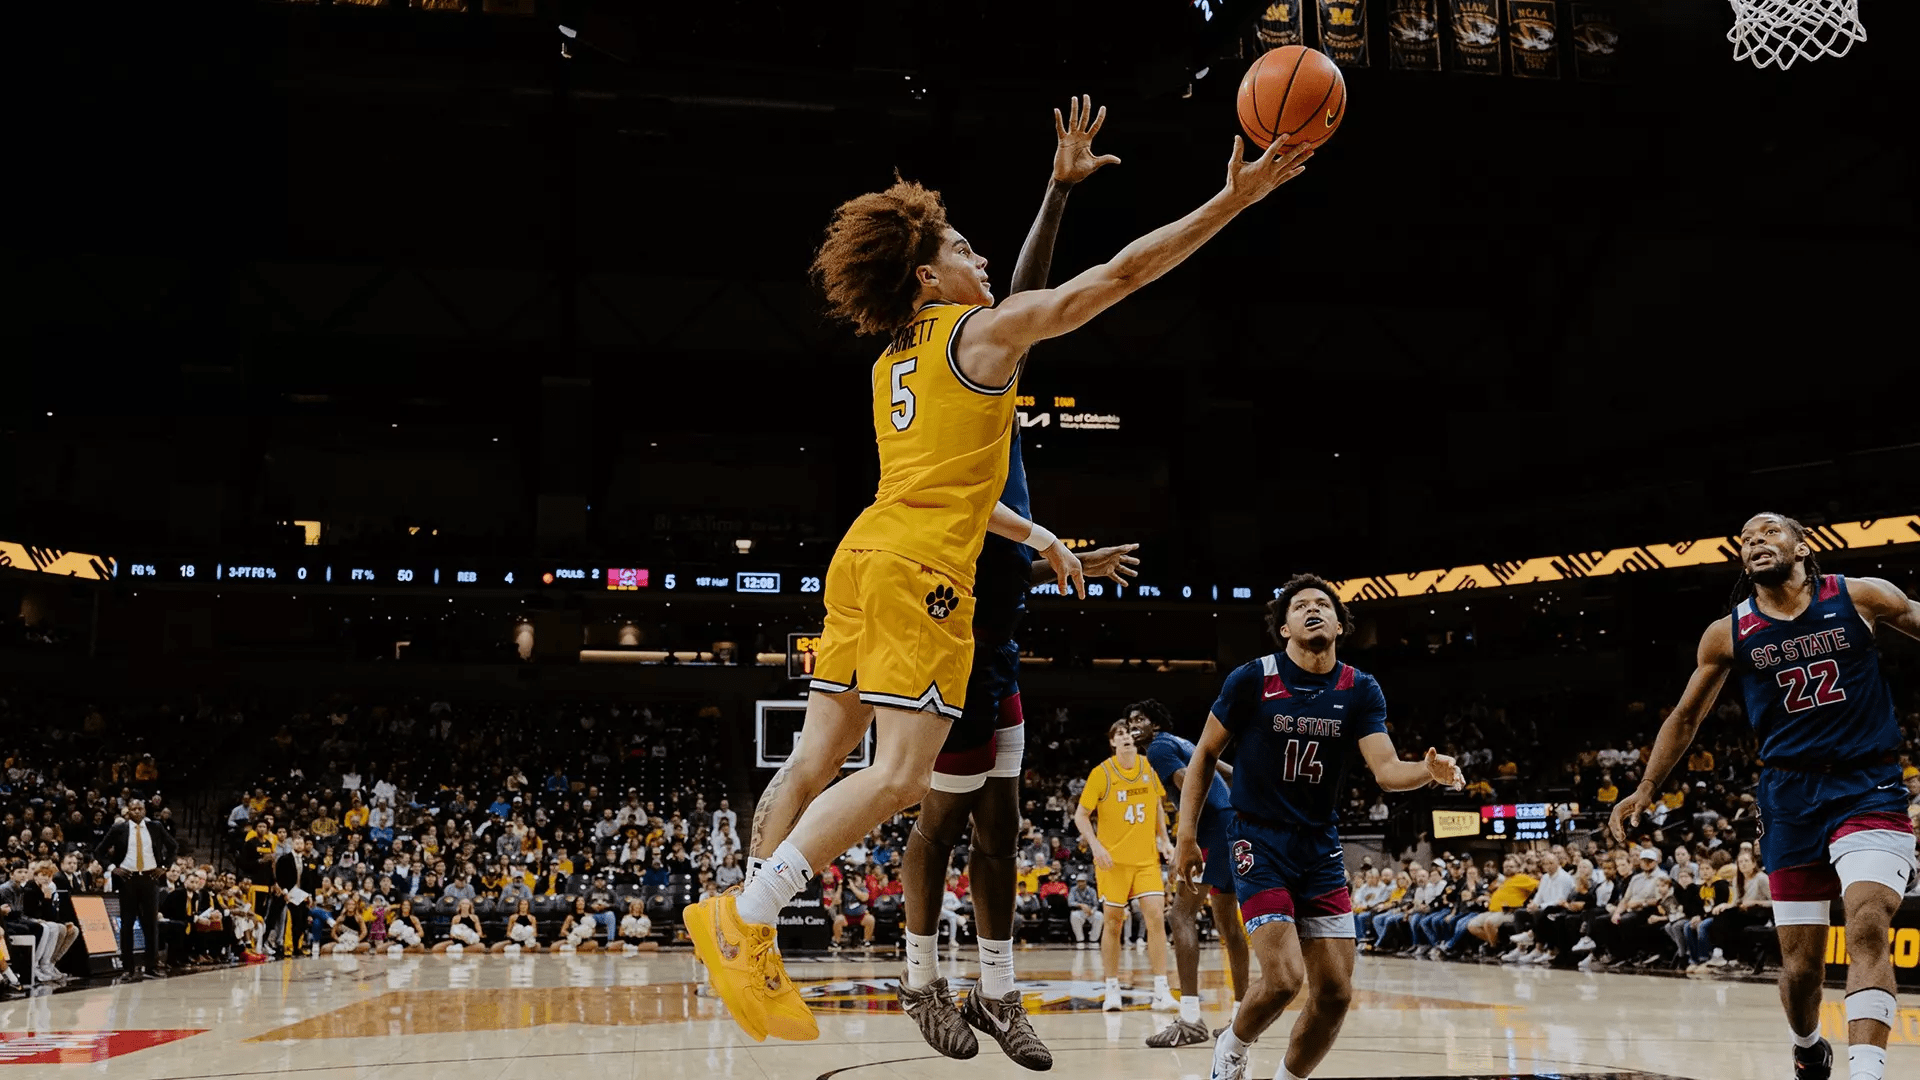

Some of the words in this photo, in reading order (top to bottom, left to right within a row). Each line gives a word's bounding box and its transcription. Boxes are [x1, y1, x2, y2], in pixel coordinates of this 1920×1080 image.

[1516, 7, 1548, 20] NCAA
[890, 356, 918, 432] 5
[1074, 413, 1084, 422] of
[131, 565, 145, 576] FG
[179, 565, 195, 578] 18
[252, 567, 265, 578] FG
[297, 567, 307, 580] 0
[351, 568, 364, 580] FT
[397, 568, 414, 582] 50
[457, 571, 477, 583] REB
[504, 571, 514, 584] 4
[591, 568, 600, 580] 2
[665, 574, 676, 590] 5
[696, 577, 711, 587] 1ST
[800, 576, 821, 593] 23
[1088, 583, 1103, 596] 50
[1138, 585, 1151, 597] FT
[1182, 585, 1192, 598] 0
[1232, 586, 1252, 599] REB
[931, 605, 946, 617] M
[1751, 643, 1781, 670] SC
[1781, 627, 1851, 662] STATE
[1775, 658, 1847, 714] 22
[1273, 713, 1293, 733] SC
[1297, 717, 1342, 737] STATE
[1283, 739, 1323, 784] 14
[1124, 803, 1146, 825] 45
[805, 915, 826, 926] Care
